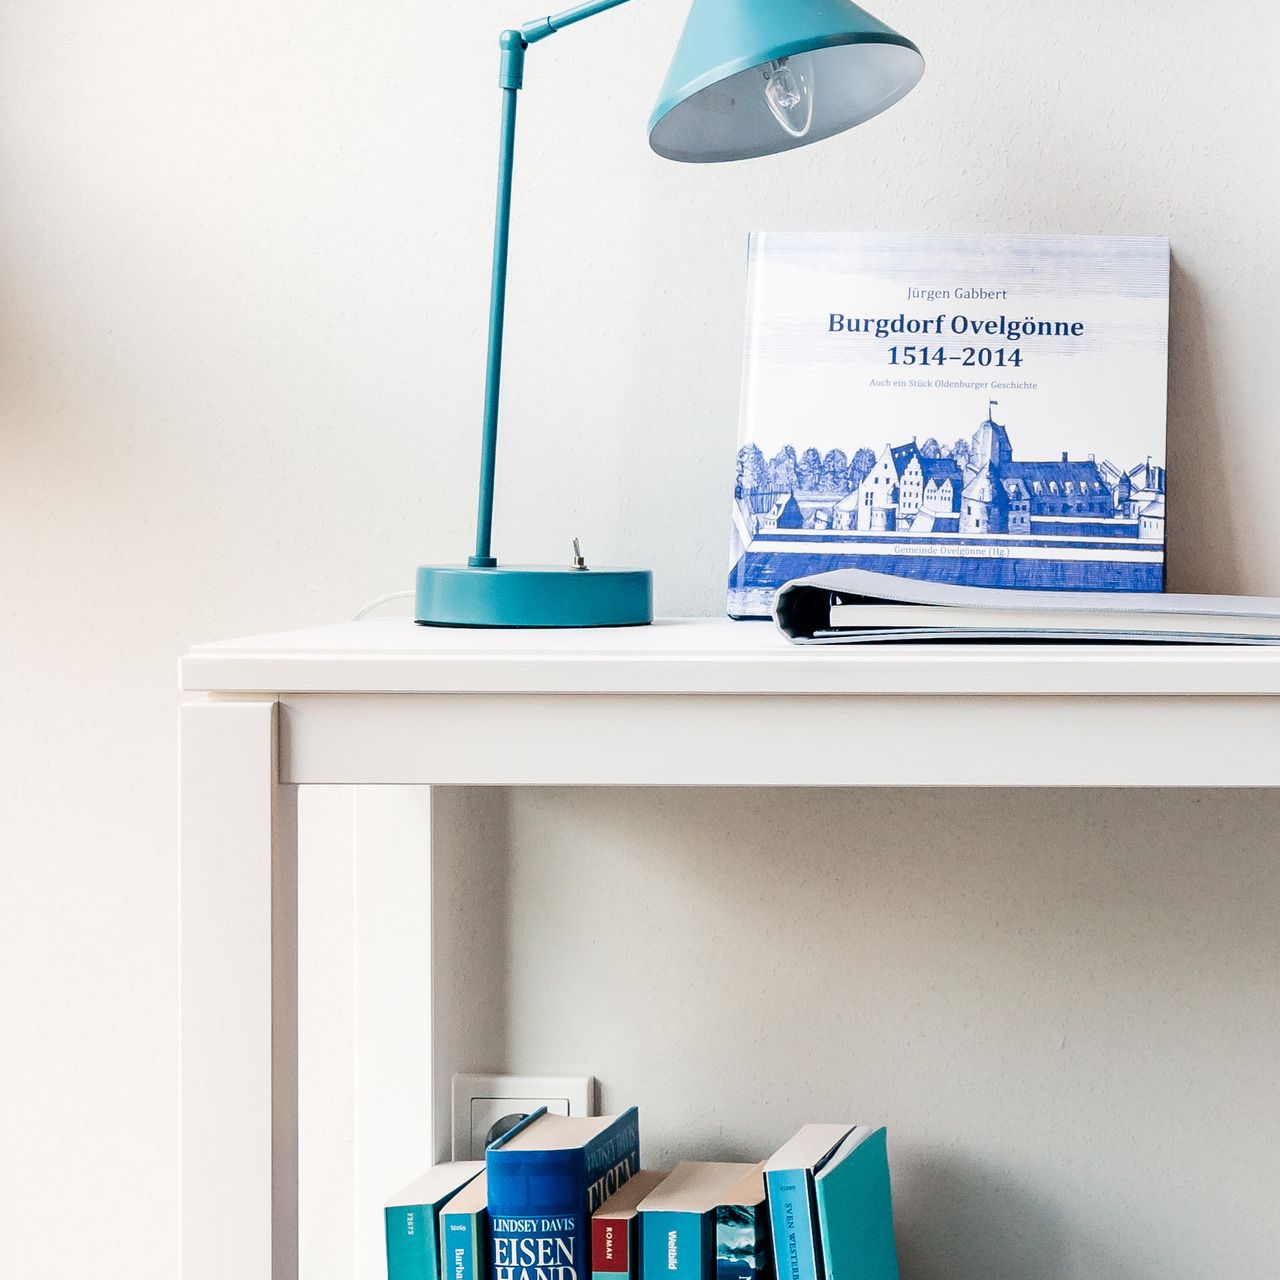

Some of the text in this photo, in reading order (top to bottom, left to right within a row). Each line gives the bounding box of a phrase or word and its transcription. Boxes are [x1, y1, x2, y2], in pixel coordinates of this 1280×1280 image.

[907, 287, 1008, 301] Jürgen Gabbert
[828, 313, 1085, 340] Burgdorf Ovelgönne
[887, 346, 1023, 367] 1514–2014
[869, 379, 1038, 390] Auch ein Stück Oldenburger Geschichte
[894, 546, 938, 555] Gemeinde
[940, 546, 986, 557] Ovelgönne
[493, 1217, 575, 1233] LINDSEY DAVIS
[784, 1202, 795, 1229] SVEN
[493, 1236, 575, 1267] EISEN
[605, 1227, 613, 1260] ROMAN
[667, 1230, 678, 1270] Weltbild
